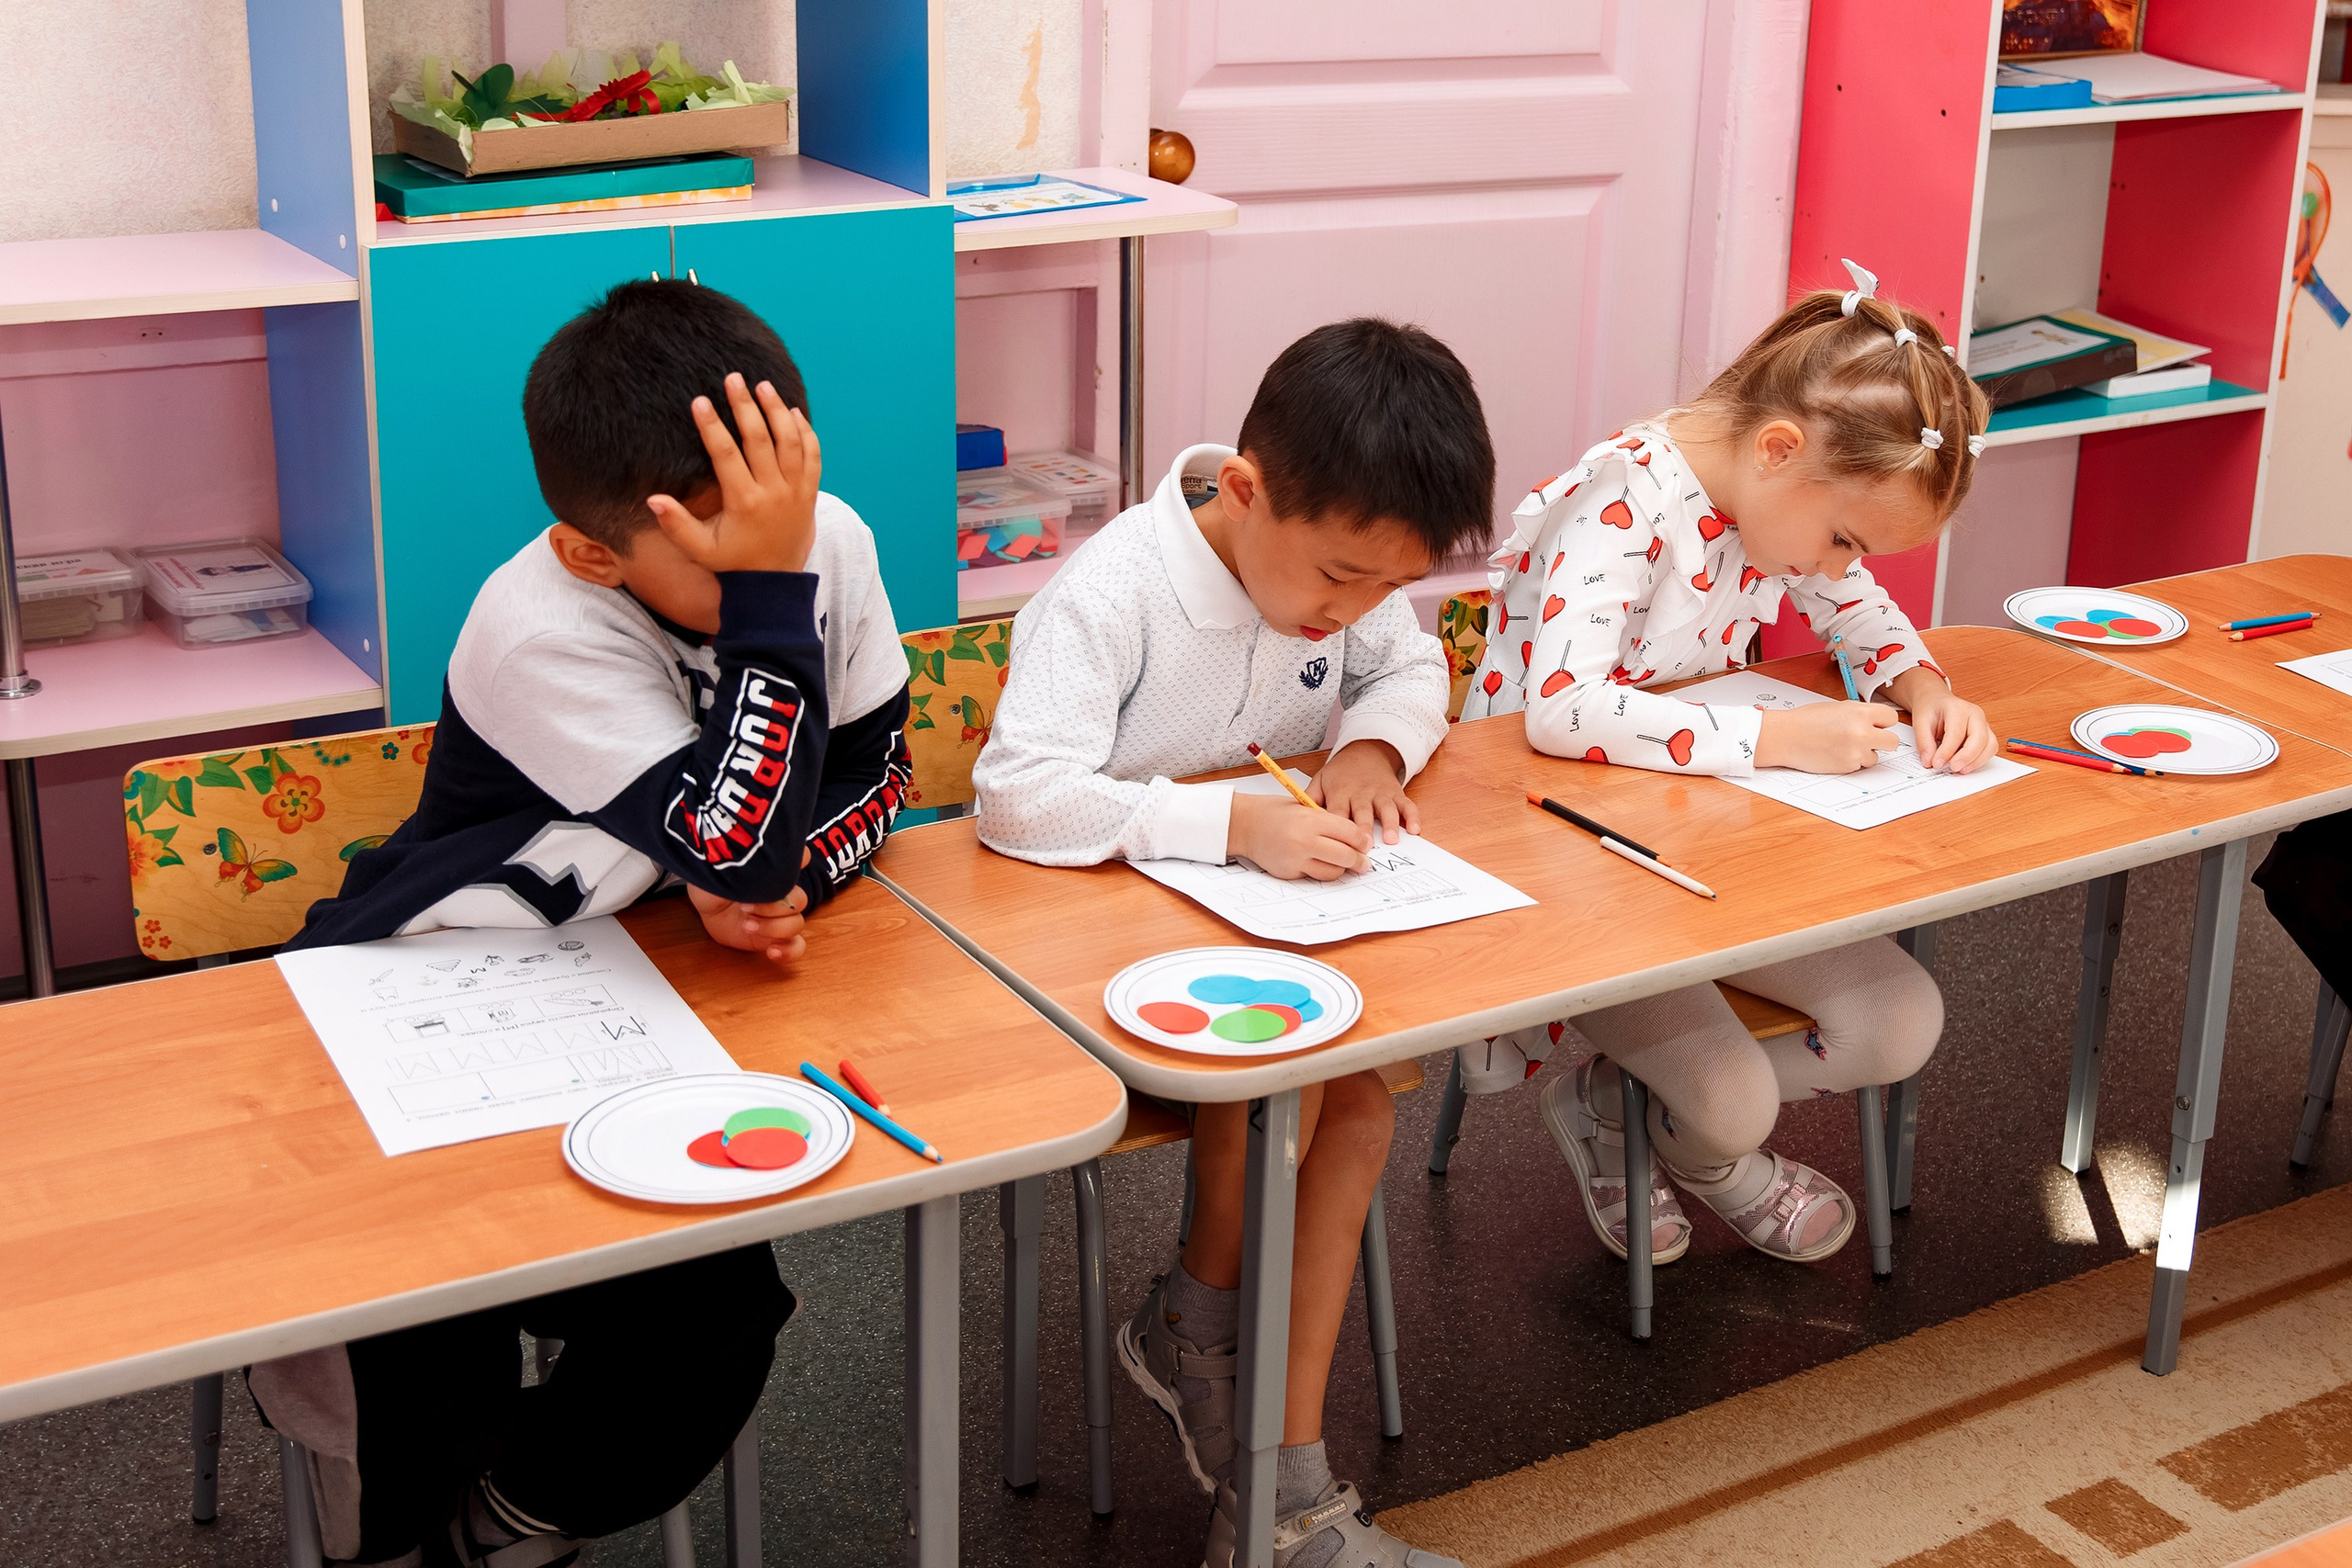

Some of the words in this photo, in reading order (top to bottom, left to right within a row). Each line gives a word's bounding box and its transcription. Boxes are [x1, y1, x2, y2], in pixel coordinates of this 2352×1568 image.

[1584, 574, 1606, 585] LOVE
[1634, 605, 1650, 615] LOV
[1590, 614, 1611, 626] LOVE
[1615, 694, 1629, 716] LOVE
[1570, 705, 1581, 732] LOVE
[1739, 739, 1753, 759] LOVE
